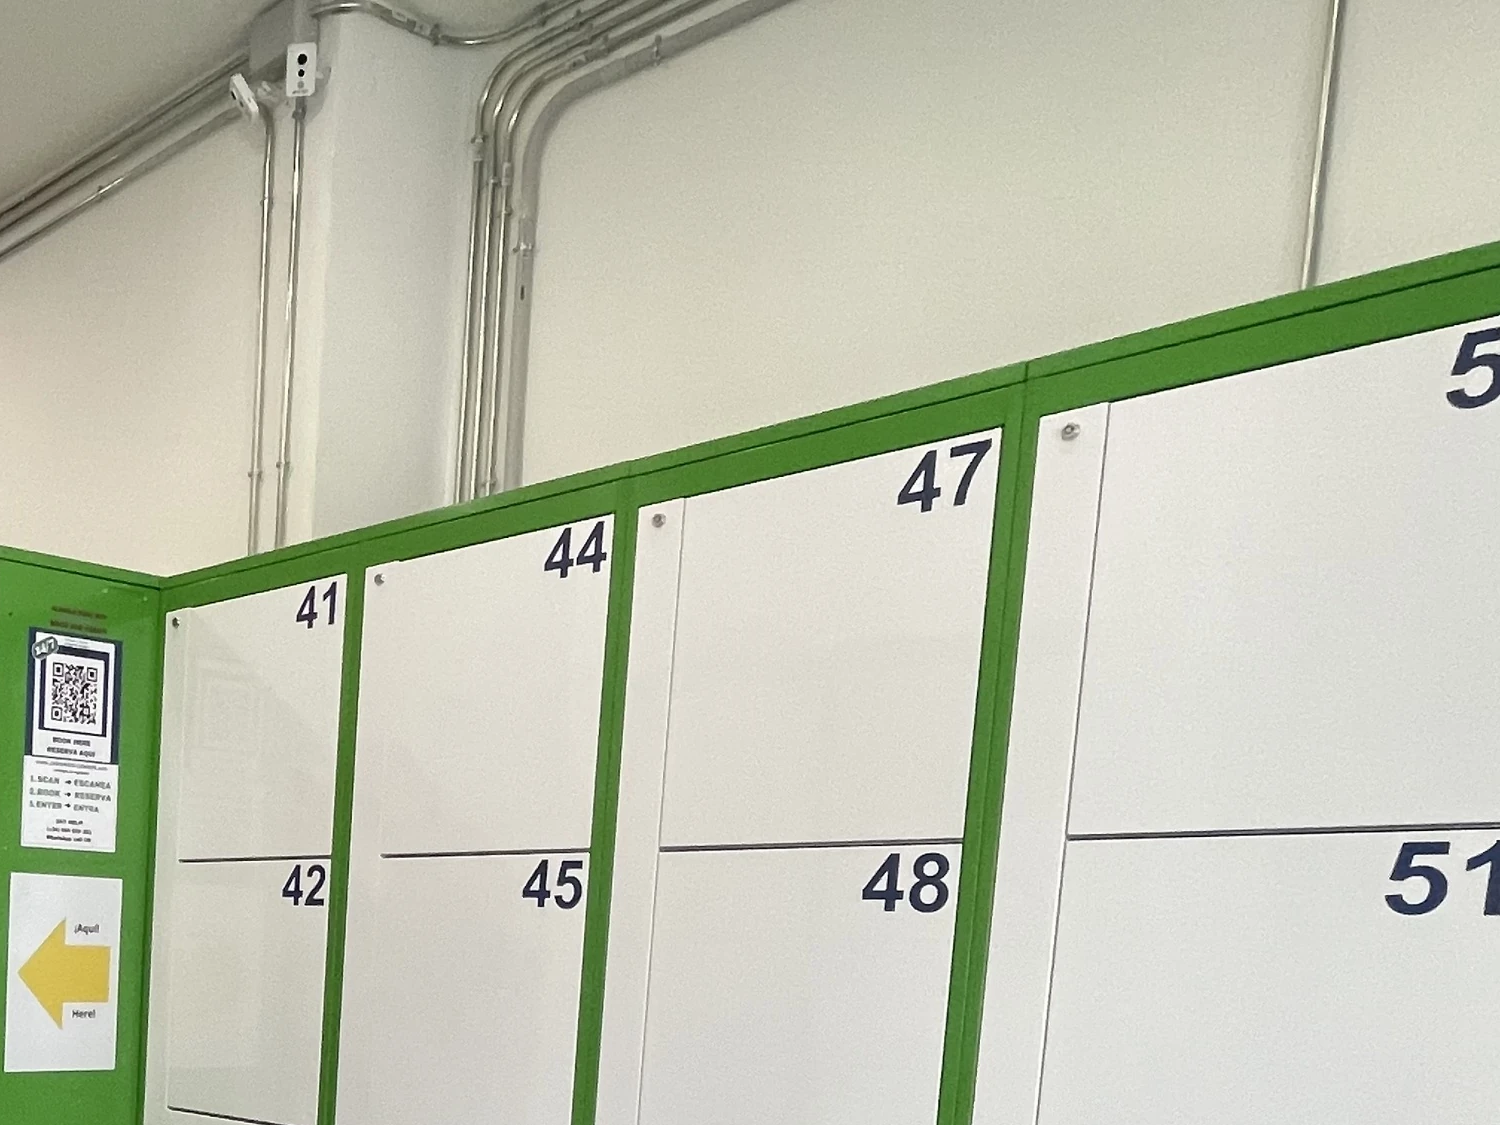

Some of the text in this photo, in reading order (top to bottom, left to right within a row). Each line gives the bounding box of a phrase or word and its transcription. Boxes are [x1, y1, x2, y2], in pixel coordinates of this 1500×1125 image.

[897, 438, 992, 513] 47
[544, 521, 607, 579] 44
[296, 581, 337, 629] 41
[282, 864, 326, 906] 42
[522, 859, 583, 909] 45
[862, 852, 950, 913] 48
[1384, 839, 1500, 915] 51
